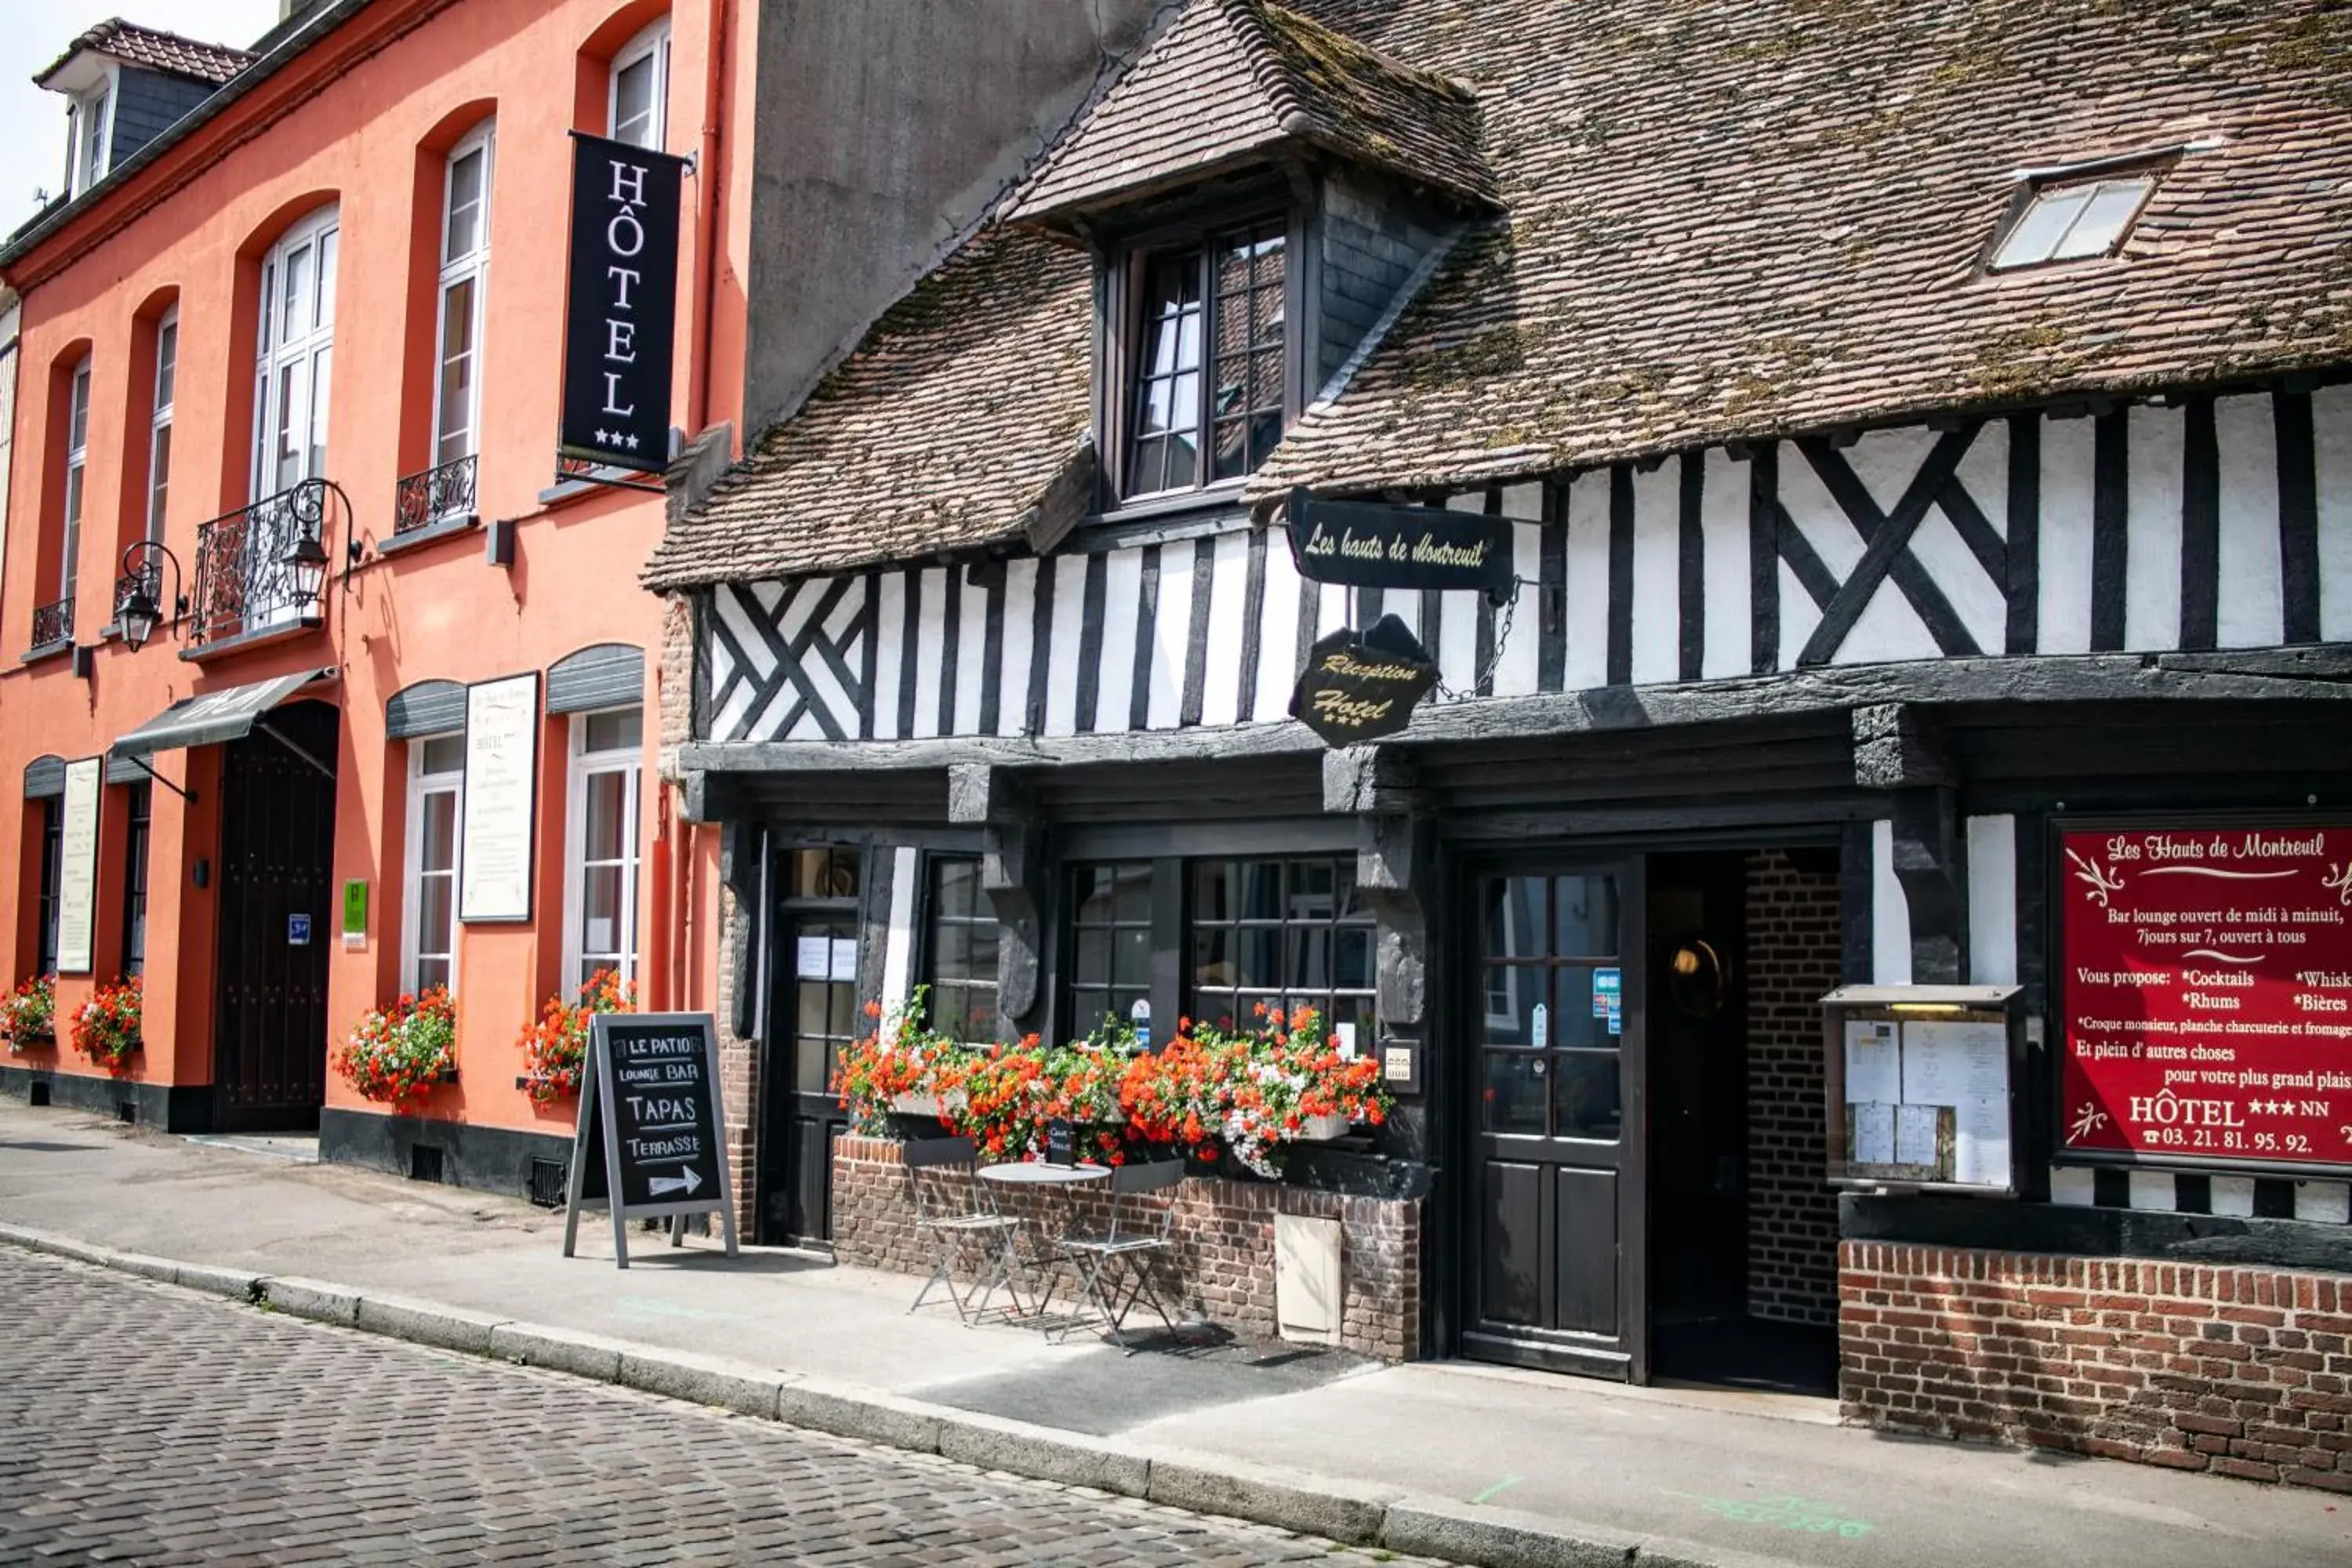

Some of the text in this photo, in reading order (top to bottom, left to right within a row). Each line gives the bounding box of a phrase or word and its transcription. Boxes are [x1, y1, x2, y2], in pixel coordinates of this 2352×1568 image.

[602, 160, 648, 416] HÔTEL
[1305, 522, 1484, 568] Les hauts de Montreuil
[2107, 833, 2325, 861] Les Hauts de Montreuil
[2107, 907, 2344, 926] Bar lounge ouvert de midi à minuit,
[2180, 933, 2201, 943] sur
[2205, 928, 2216, 946] 7,
[2220, 931, 2263, 943] ouvert
[2267, 928, 2274, 943] à
[2278, 931, 2307, 943] tous
[2078, 967, 2110, 983] Vous
[2114, 972, 2171, 987] propose:
[2125, 1020, 2178, 1033] monsieur,
[2180, 1019, 2223, 1034] planche
[2226, 1021, 2288, 1034] charcuterie
[2292, 1022, 2303, 1034] et
[630, 1037, 690, 1054] LE PATIO
[2076, 1040, 2092, 1056] Et
[2095, 1041, 2128, 1060] plein
[2147, 1046, 2187, 1058] autres
[2190, 1044, 2235, 1061] choses
[666, 1064, 699, 1080] BAR
[2165, 1070, 2197, 1086] pour
[2200, 1071, 2235, 1083] votre
[2239, 1068, 2268, 1088] plus
[2272, 1071, 2313, 1089] grand
[626, 1096, 696, 1121] TAPAS
[2129, 1087, 2330, 1127] HÔTEL NN
[626, 1136, 701, 1157] TERRASSE
